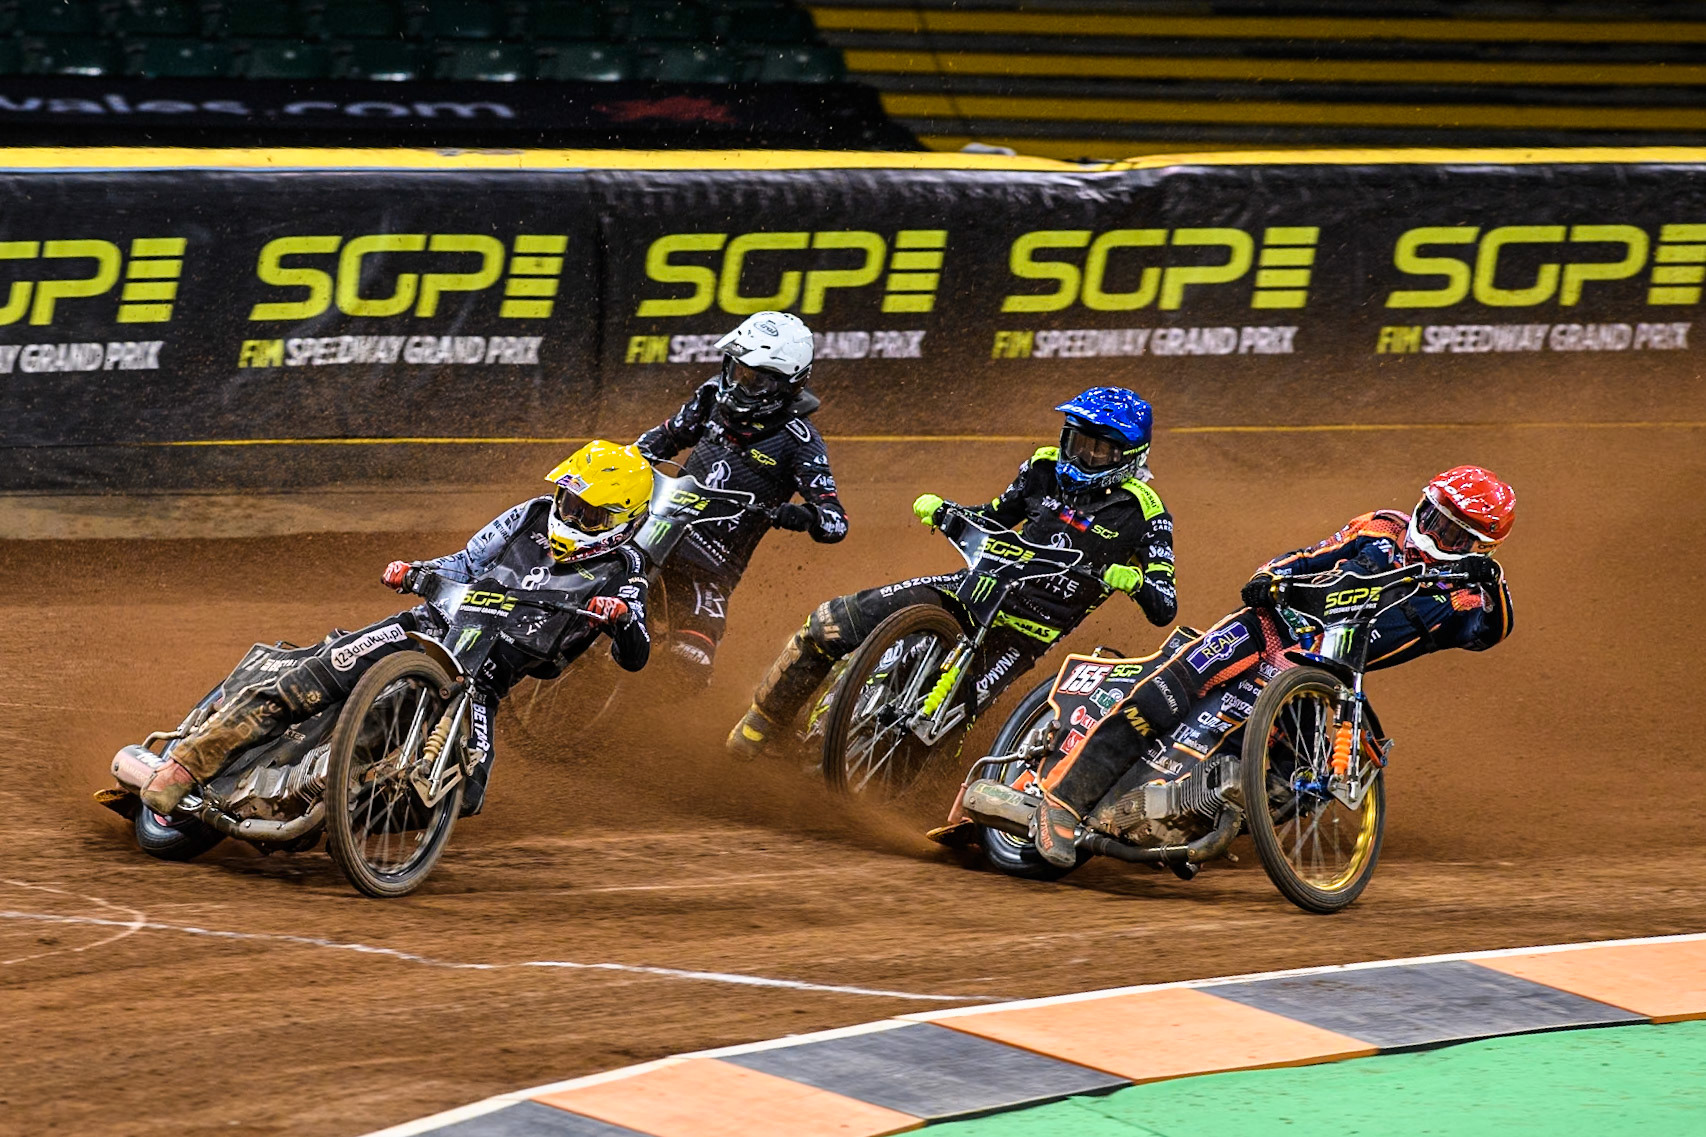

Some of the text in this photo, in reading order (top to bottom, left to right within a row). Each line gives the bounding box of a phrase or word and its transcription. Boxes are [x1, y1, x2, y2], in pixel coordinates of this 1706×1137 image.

[285, 335, 405, 365] SPEEDWAY
[403, 335, 487, 364] GRAND
[484, 335, 543, 364] PRIX
[869, 330, 927, 358] PRIX
[1033, 328, 1151, 358] SPEEDWAY
[1150, 327, 1240, 355] GRAND
[1238, 326, 1299, 354] PRIX
[1422, 324, 1550, 353] SPEEDWAY
[1549, 323, 1633, 351] GRAND
[1632, 322, 1692, 350] PRIX
[19, 342, 104, 373] GRAND
[103, 339, 164, 371] PRIX
[1325, 587, 1370, 610] SGP
[334, 626, 403, 665] 123drukuj.pl
[1202, 631, 1240, 659] REALL
[1059, 664, 1113, 694] 155
[1123, 706, 1153, 737] MK
